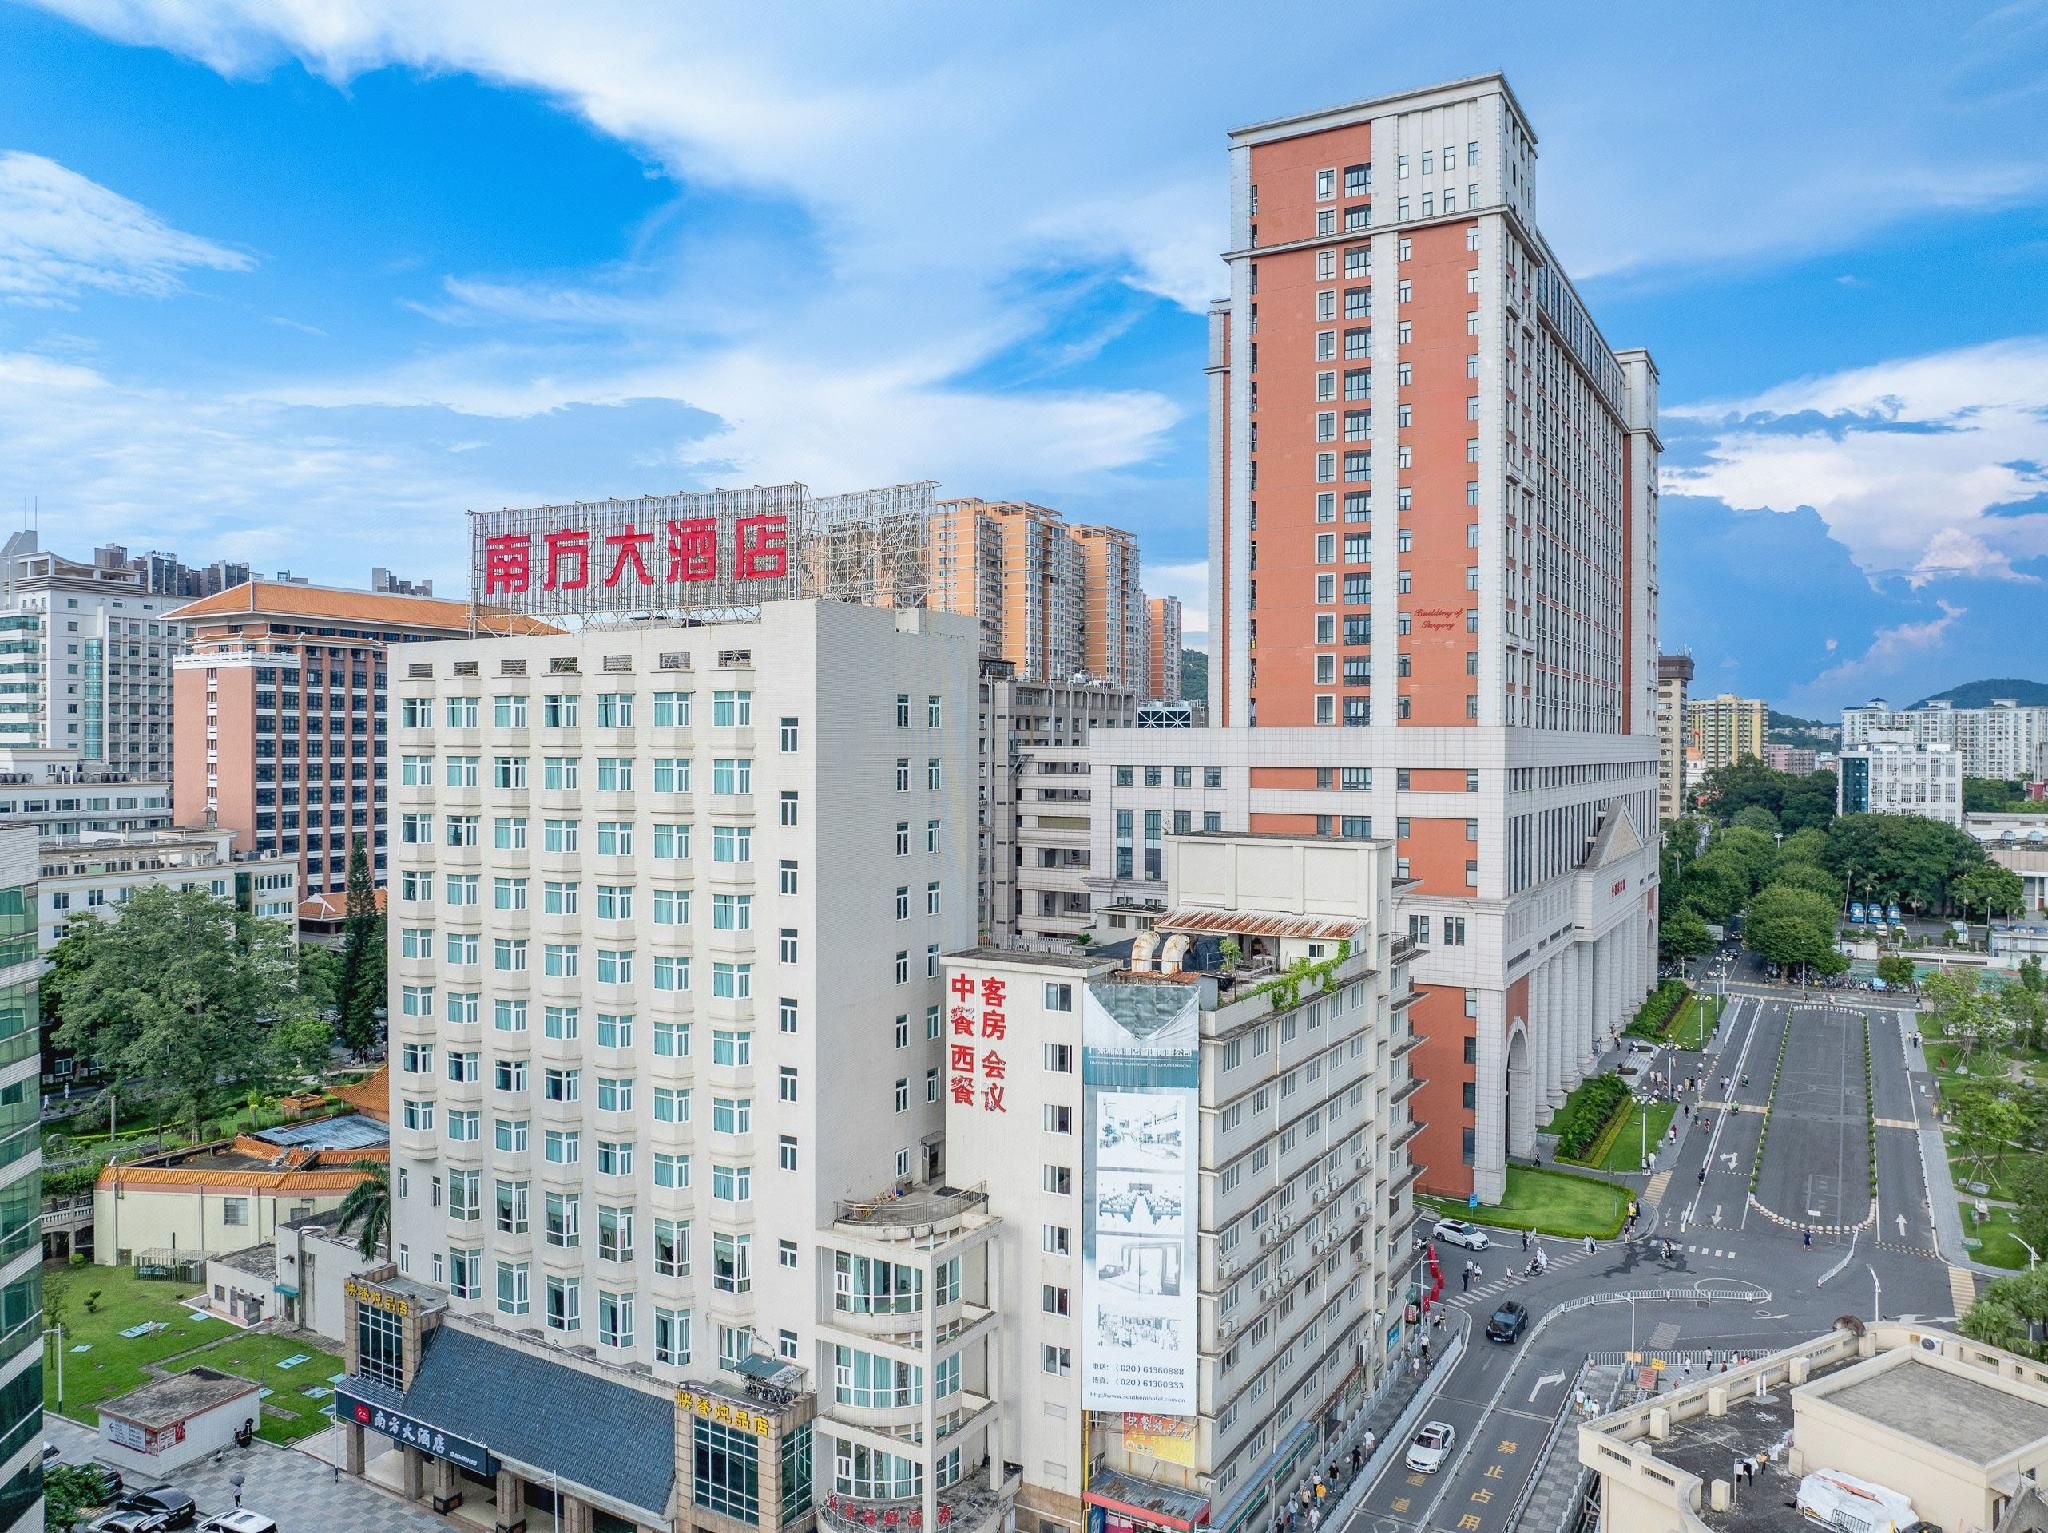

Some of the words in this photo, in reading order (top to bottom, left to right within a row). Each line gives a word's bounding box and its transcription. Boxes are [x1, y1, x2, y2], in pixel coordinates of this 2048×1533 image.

[485, 513, 787, 595] 南方大酒店
[1414, 608, 1452, 618] Building
[1453, 607, 1464, 618] of
[1421, 620, 1455, 631] Surgery
[374, 1410, 445, 1454] 南方大酒店
[677, 1391, 769, 1436] 快餐炖品店
